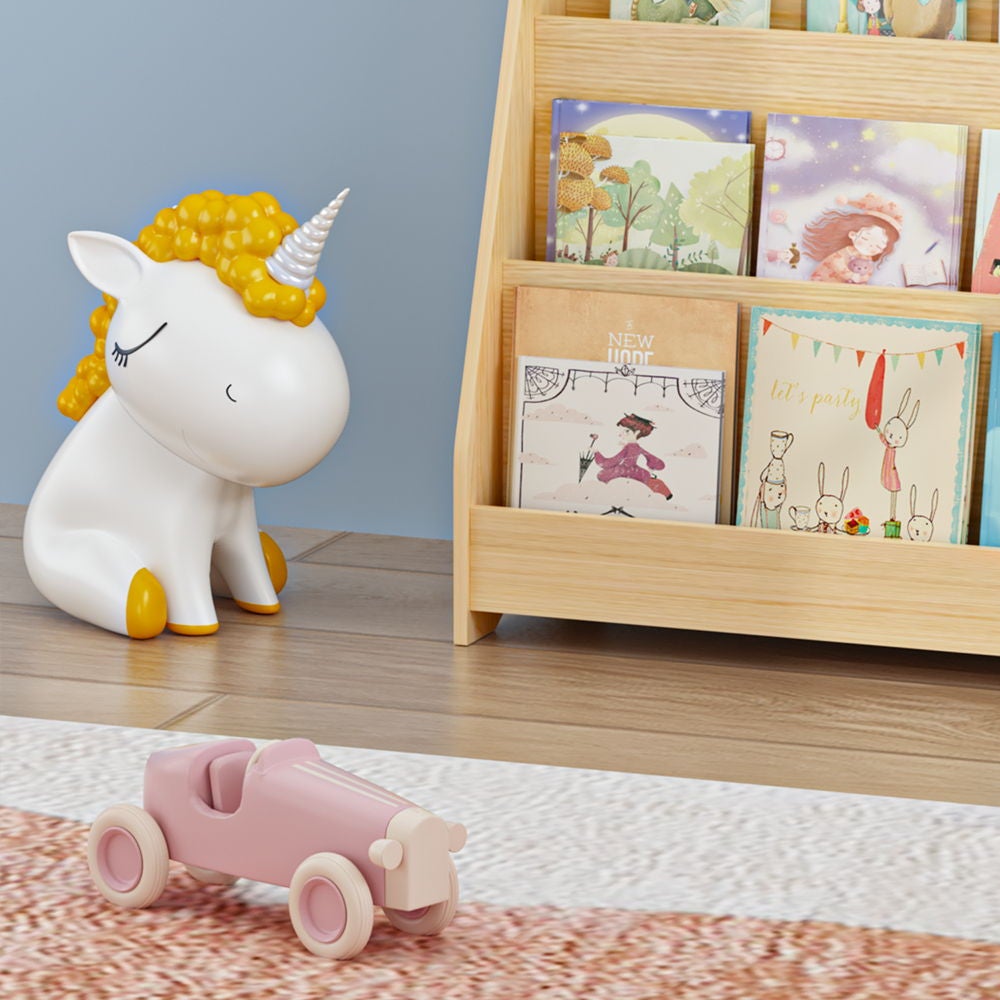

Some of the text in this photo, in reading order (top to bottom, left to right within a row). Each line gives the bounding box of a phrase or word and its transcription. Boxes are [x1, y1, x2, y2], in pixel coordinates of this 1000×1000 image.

[607, 332, 655, 349] NEW
[771, 379, 861, 421] let's party
